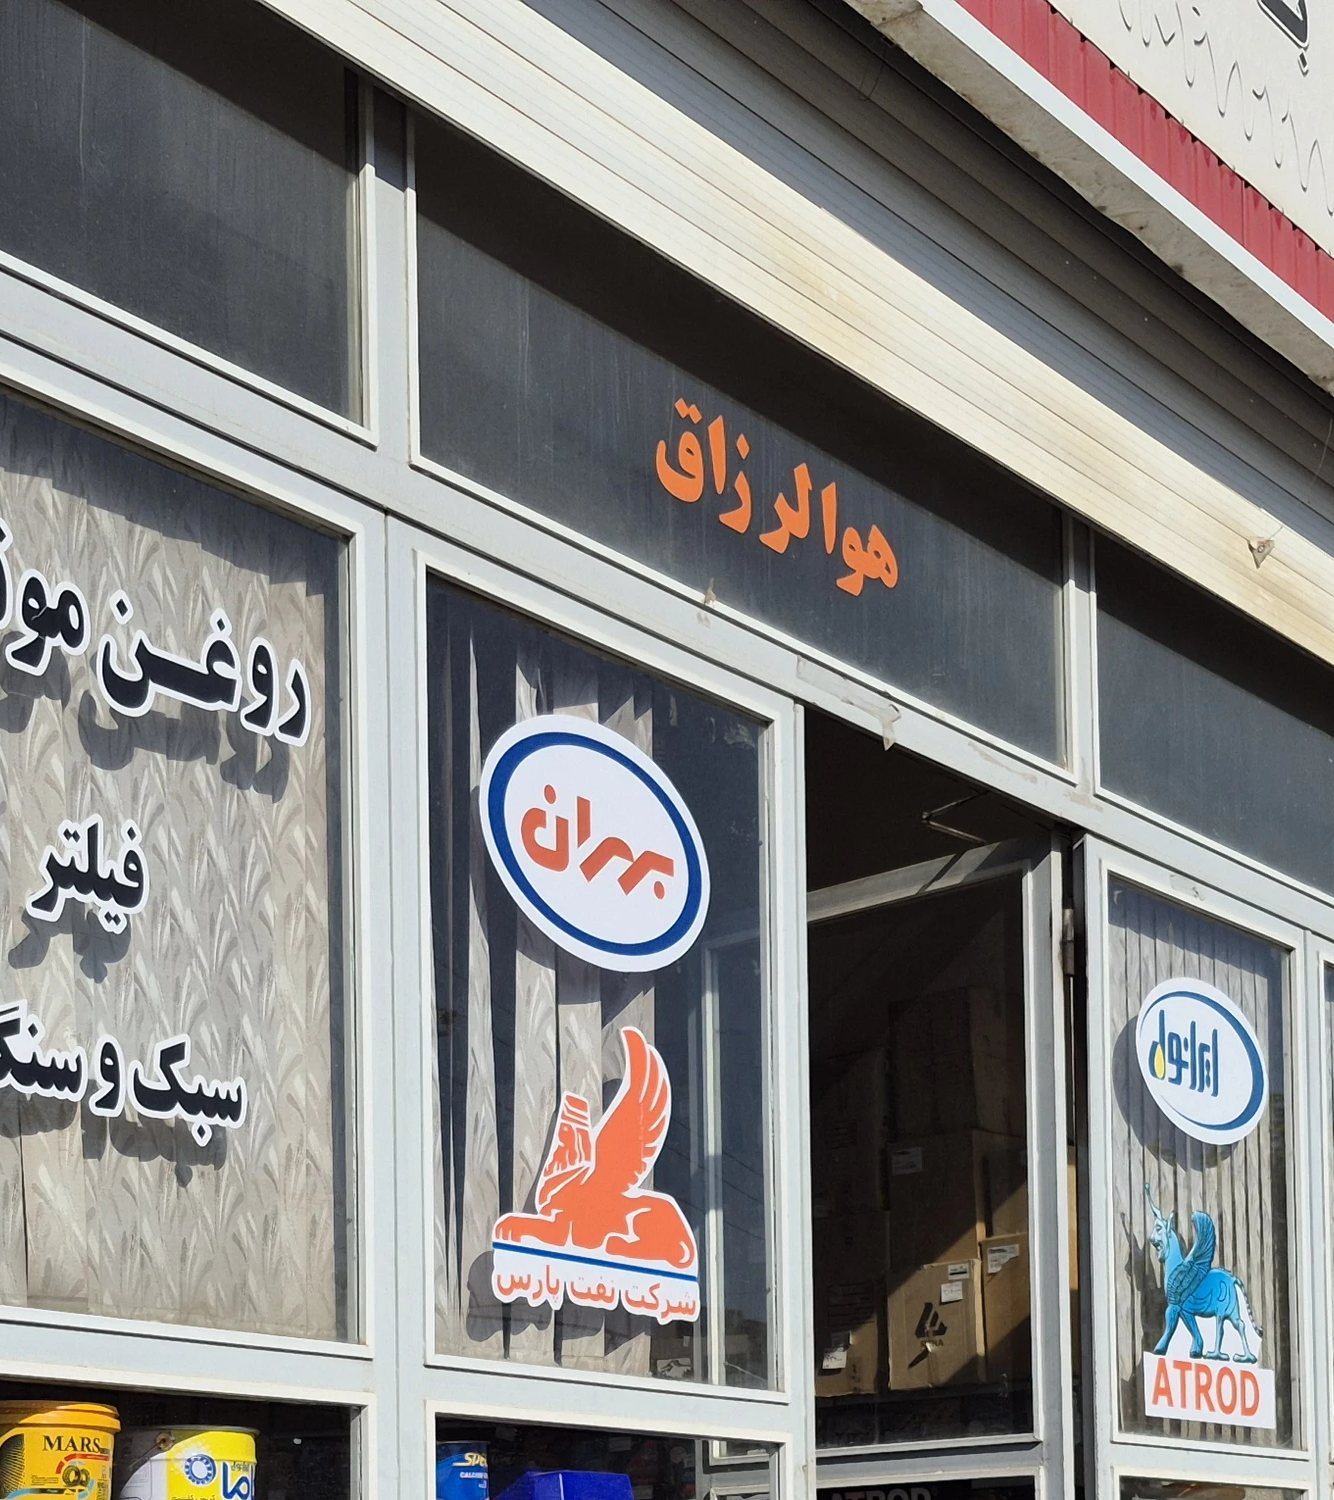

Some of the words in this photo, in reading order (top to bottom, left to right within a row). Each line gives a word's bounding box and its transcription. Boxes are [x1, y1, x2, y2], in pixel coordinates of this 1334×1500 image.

[99, 592, 311, 744] روغن
[27, 815, 149, 932] فیلتر
[521, 784, 674, 900] بهران
[89, 1034, 126, 1117] و
[128, 1034, 247, 1145] سبک
[1149, 1009, 1219, 1097] ایرانول
[497, 1265, 559, 1302] پارس
[571, 1276, 616, 1301] نفت
[626, 1283, 696, 1318] شرکت
[1152, 1360, 1259, 1417] ATROD
[43, 1435, 101, 1453] MARS
